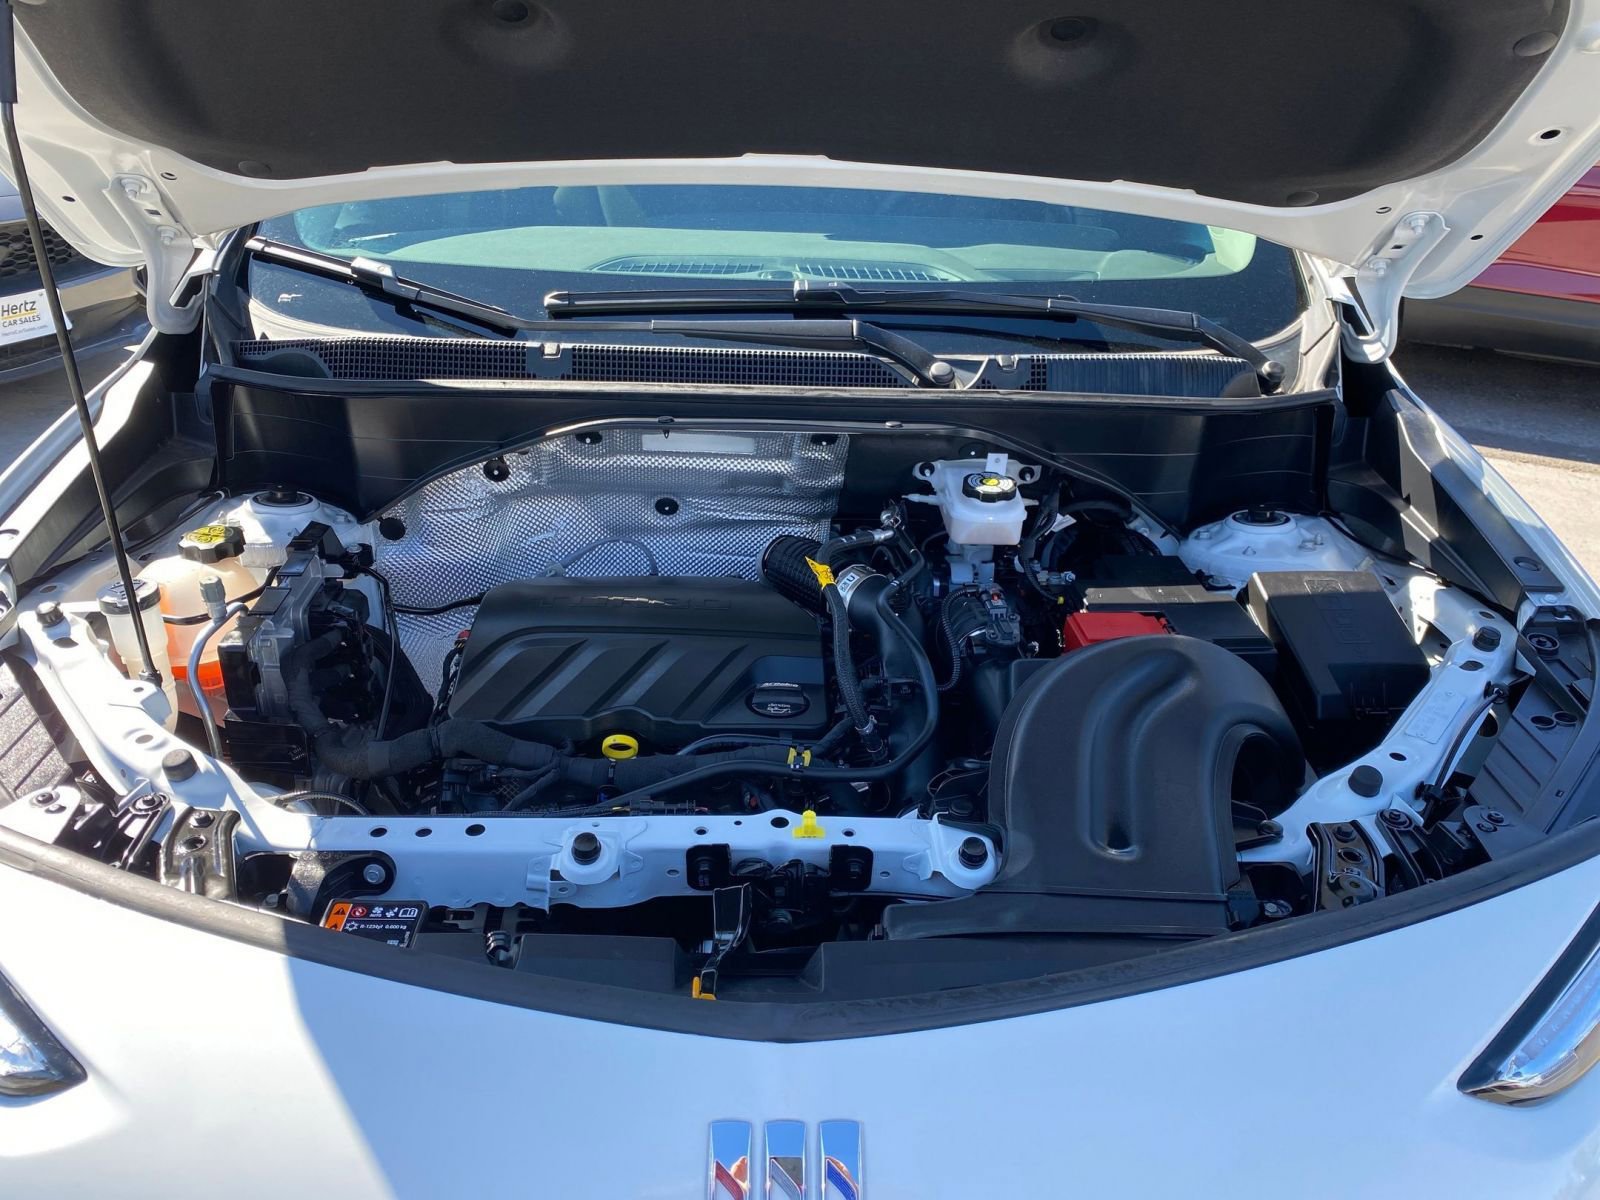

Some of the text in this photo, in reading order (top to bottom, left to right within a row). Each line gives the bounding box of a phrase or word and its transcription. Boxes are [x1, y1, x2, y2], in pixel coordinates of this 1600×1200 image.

[1, 300, 37, 317] Hertz
[2, 314, 41, 328] CAR SALES
